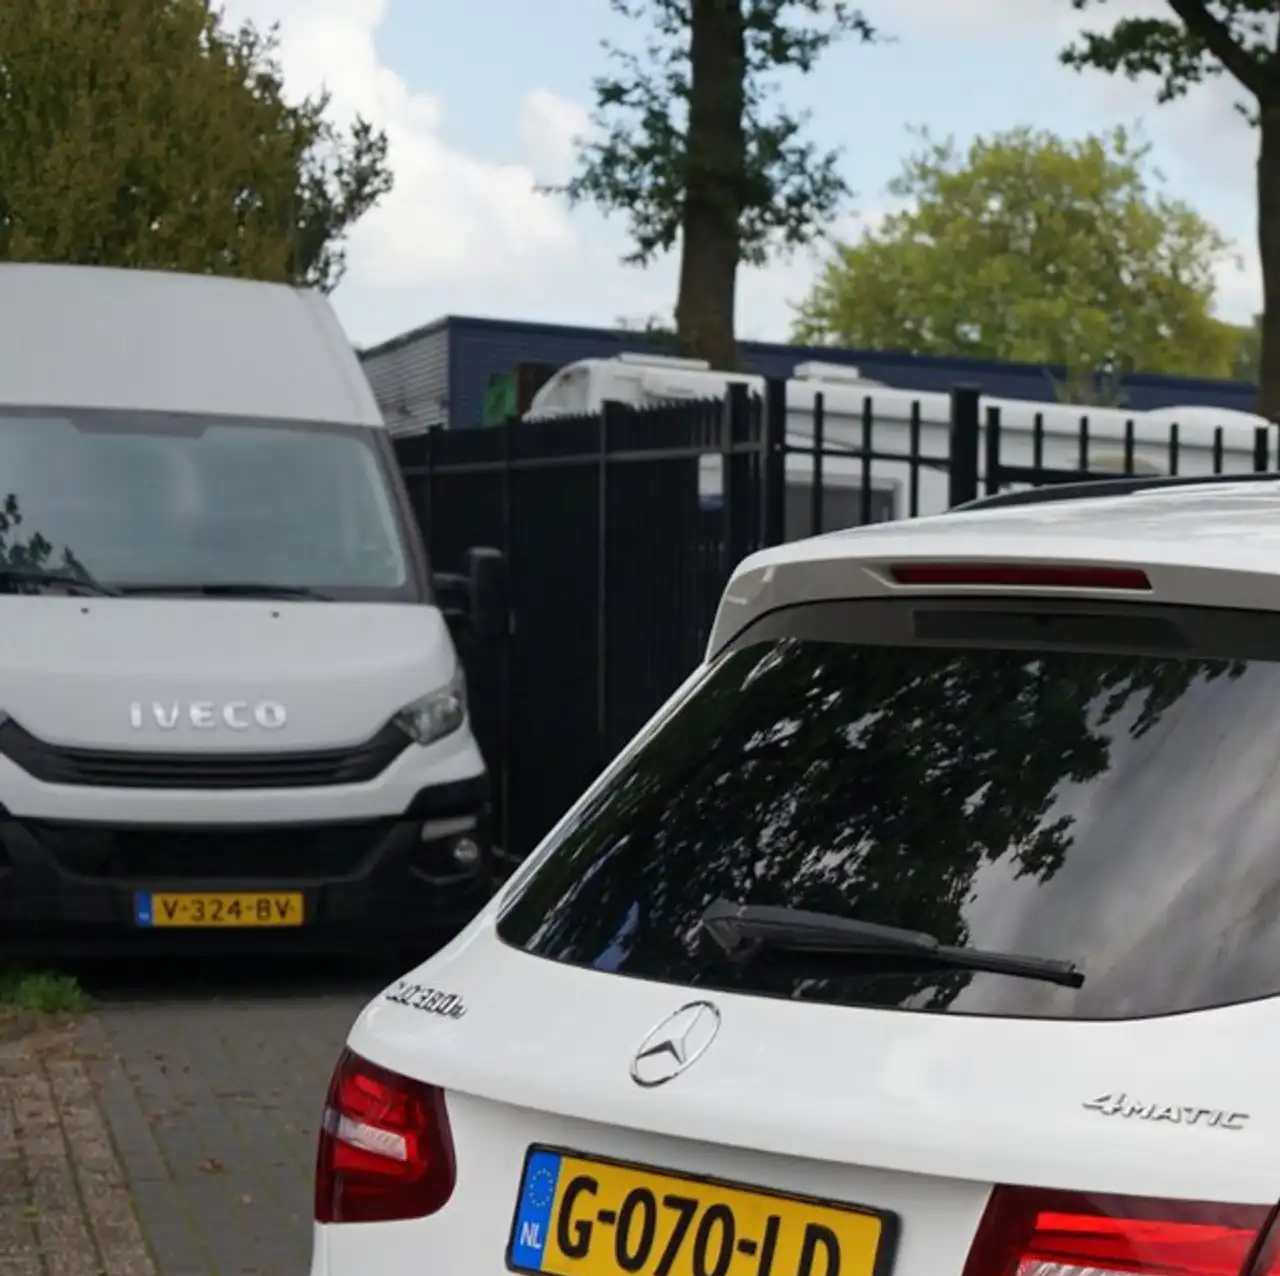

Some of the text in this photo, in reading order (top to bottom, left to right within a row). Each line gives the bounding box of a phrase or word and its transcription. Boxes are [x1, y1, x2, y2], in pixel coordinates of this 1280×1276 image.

[130, 700, 287, 729] IVECO
[161, 898, 291, 922] V-324-BV
[1082, 1092, 1250, 1130] 4MATIC
[519, 1221, 542, 1250] NL
